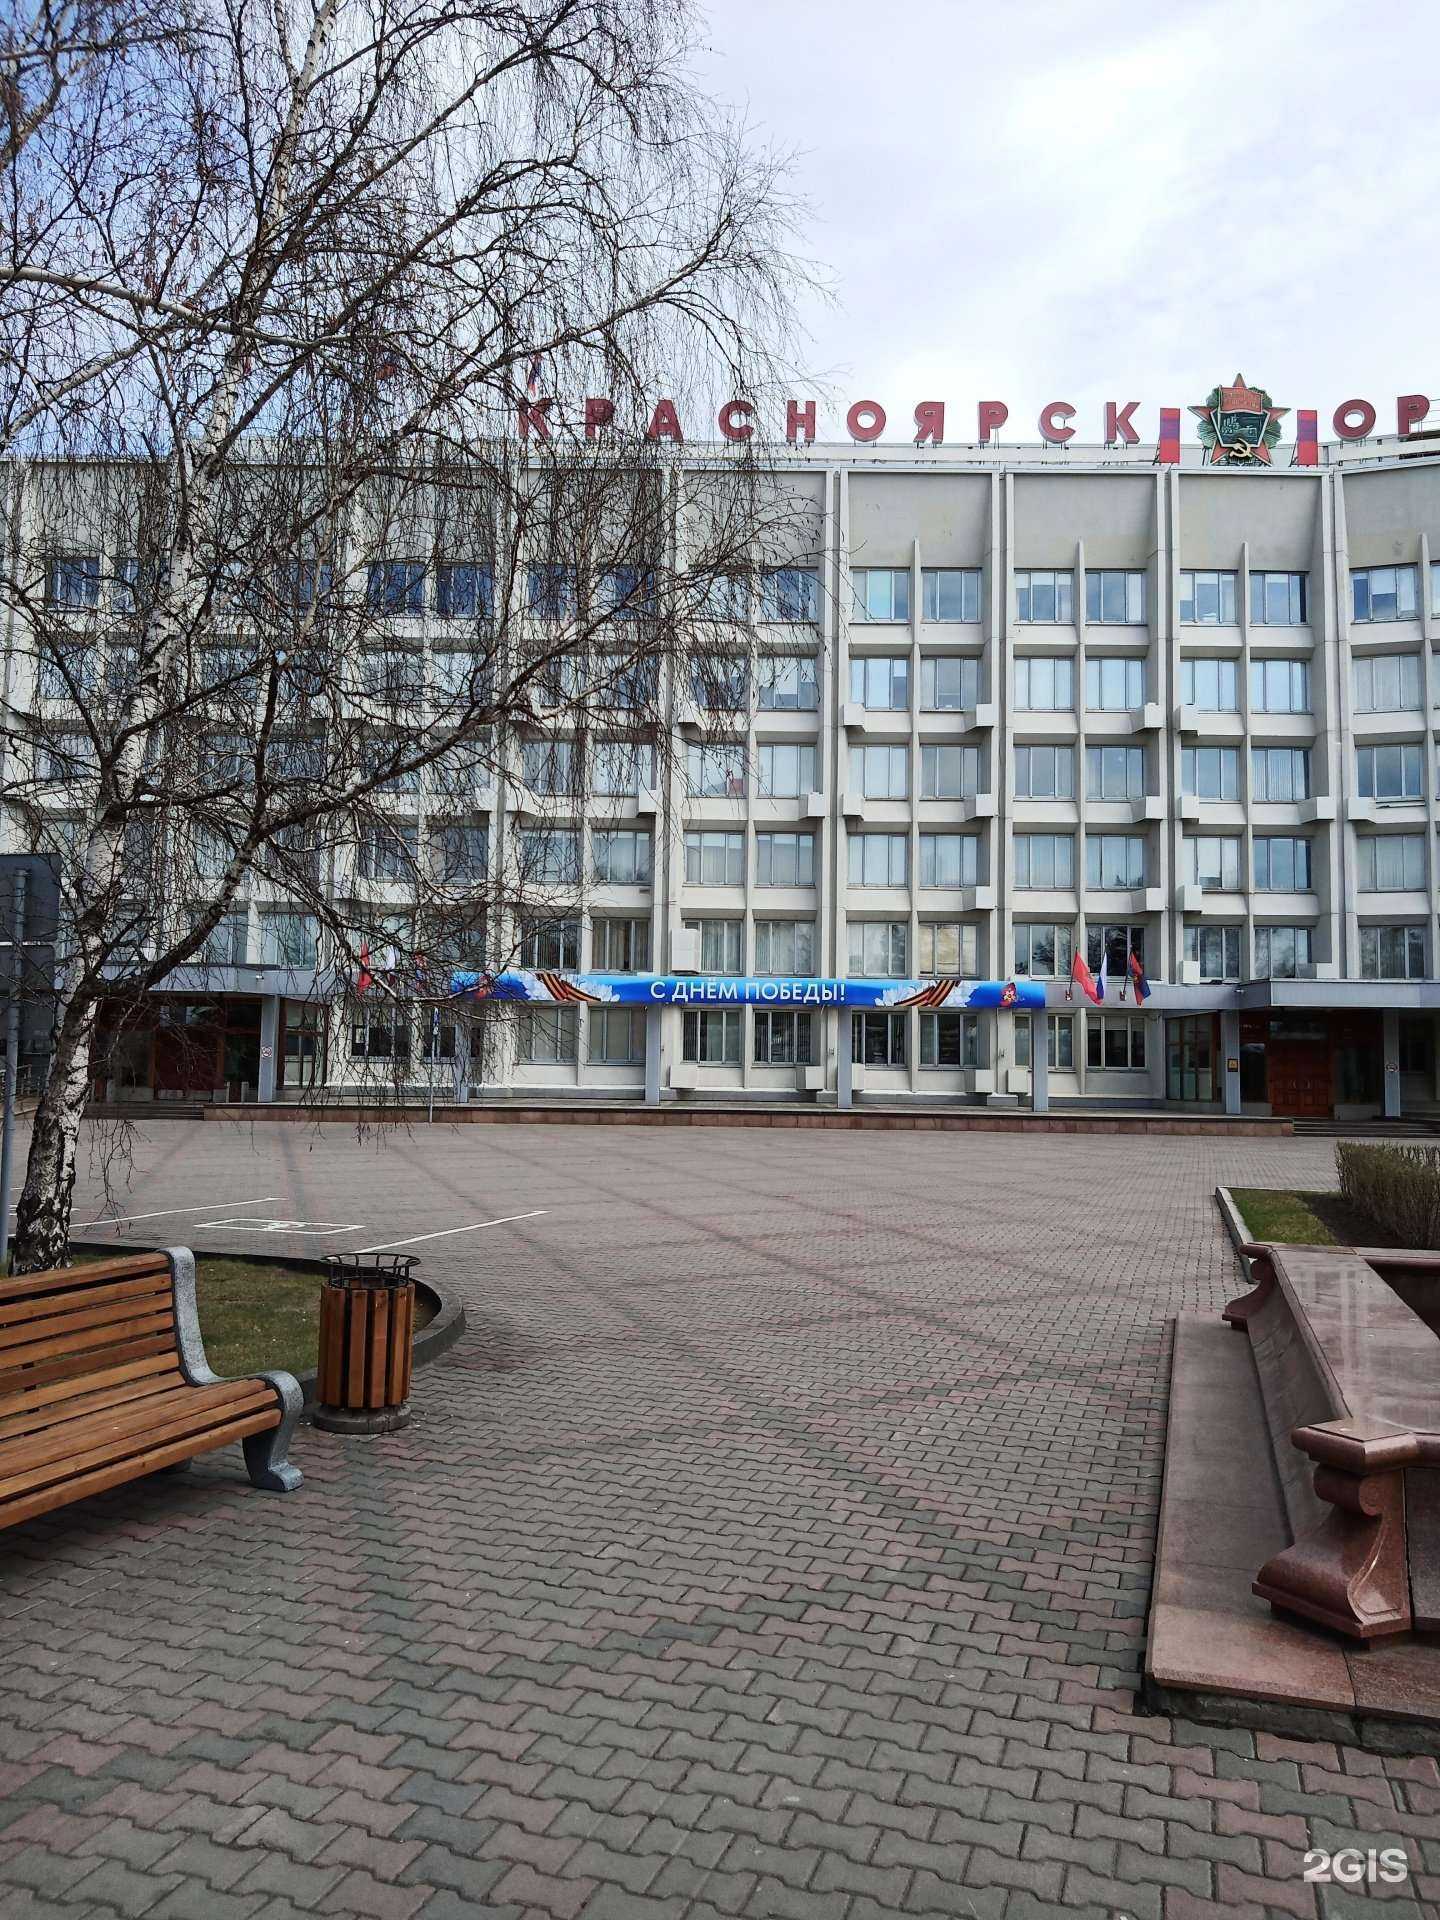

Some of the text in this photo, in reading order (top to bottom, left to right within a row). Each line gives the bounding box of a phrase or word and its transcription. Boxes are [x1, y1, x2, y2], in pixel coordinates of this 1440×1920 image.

[518, 398, 1141, 444] КРАСНОЯРСК
[650, 979, 846, 1003] С ДНЁМ ПОБЕДЫ!
